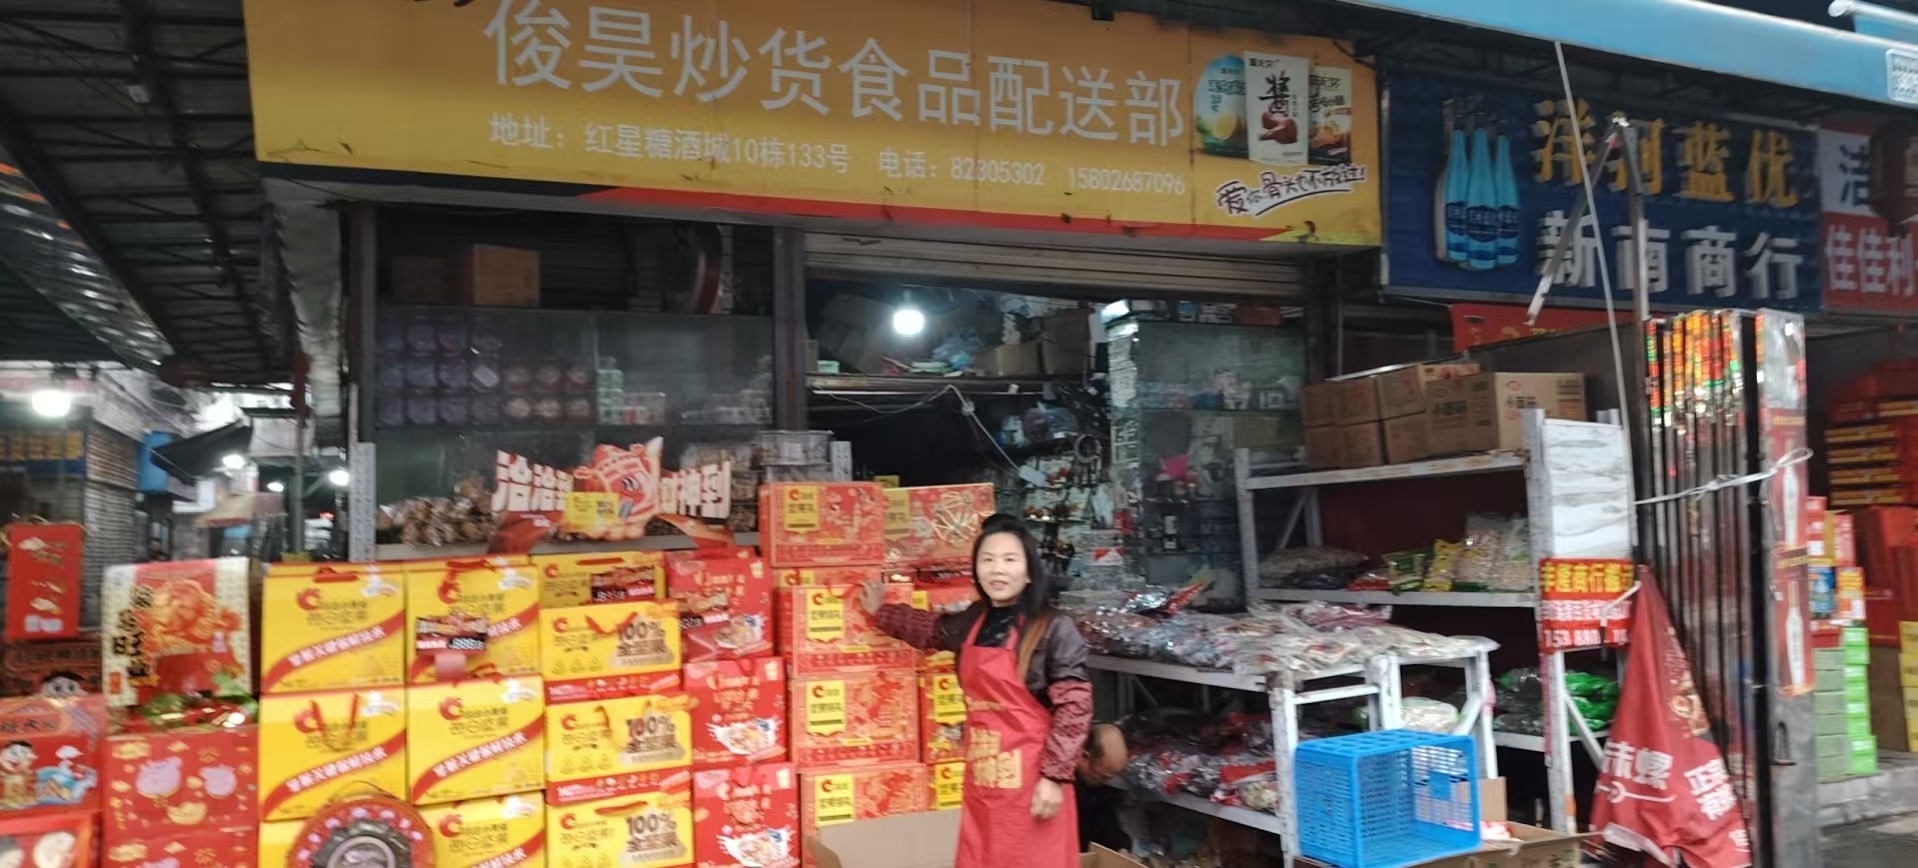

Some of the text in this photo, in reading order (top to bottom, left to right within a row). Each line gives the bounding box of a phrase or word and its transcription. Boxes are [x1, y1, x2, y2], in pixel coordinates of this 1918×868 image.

[484, 0, 1186, 148] 俊昊炒货食品配送部
[1067, 166, 1187, 197] 15802687096
[1536, 210, 1802, 300] 新南商行
